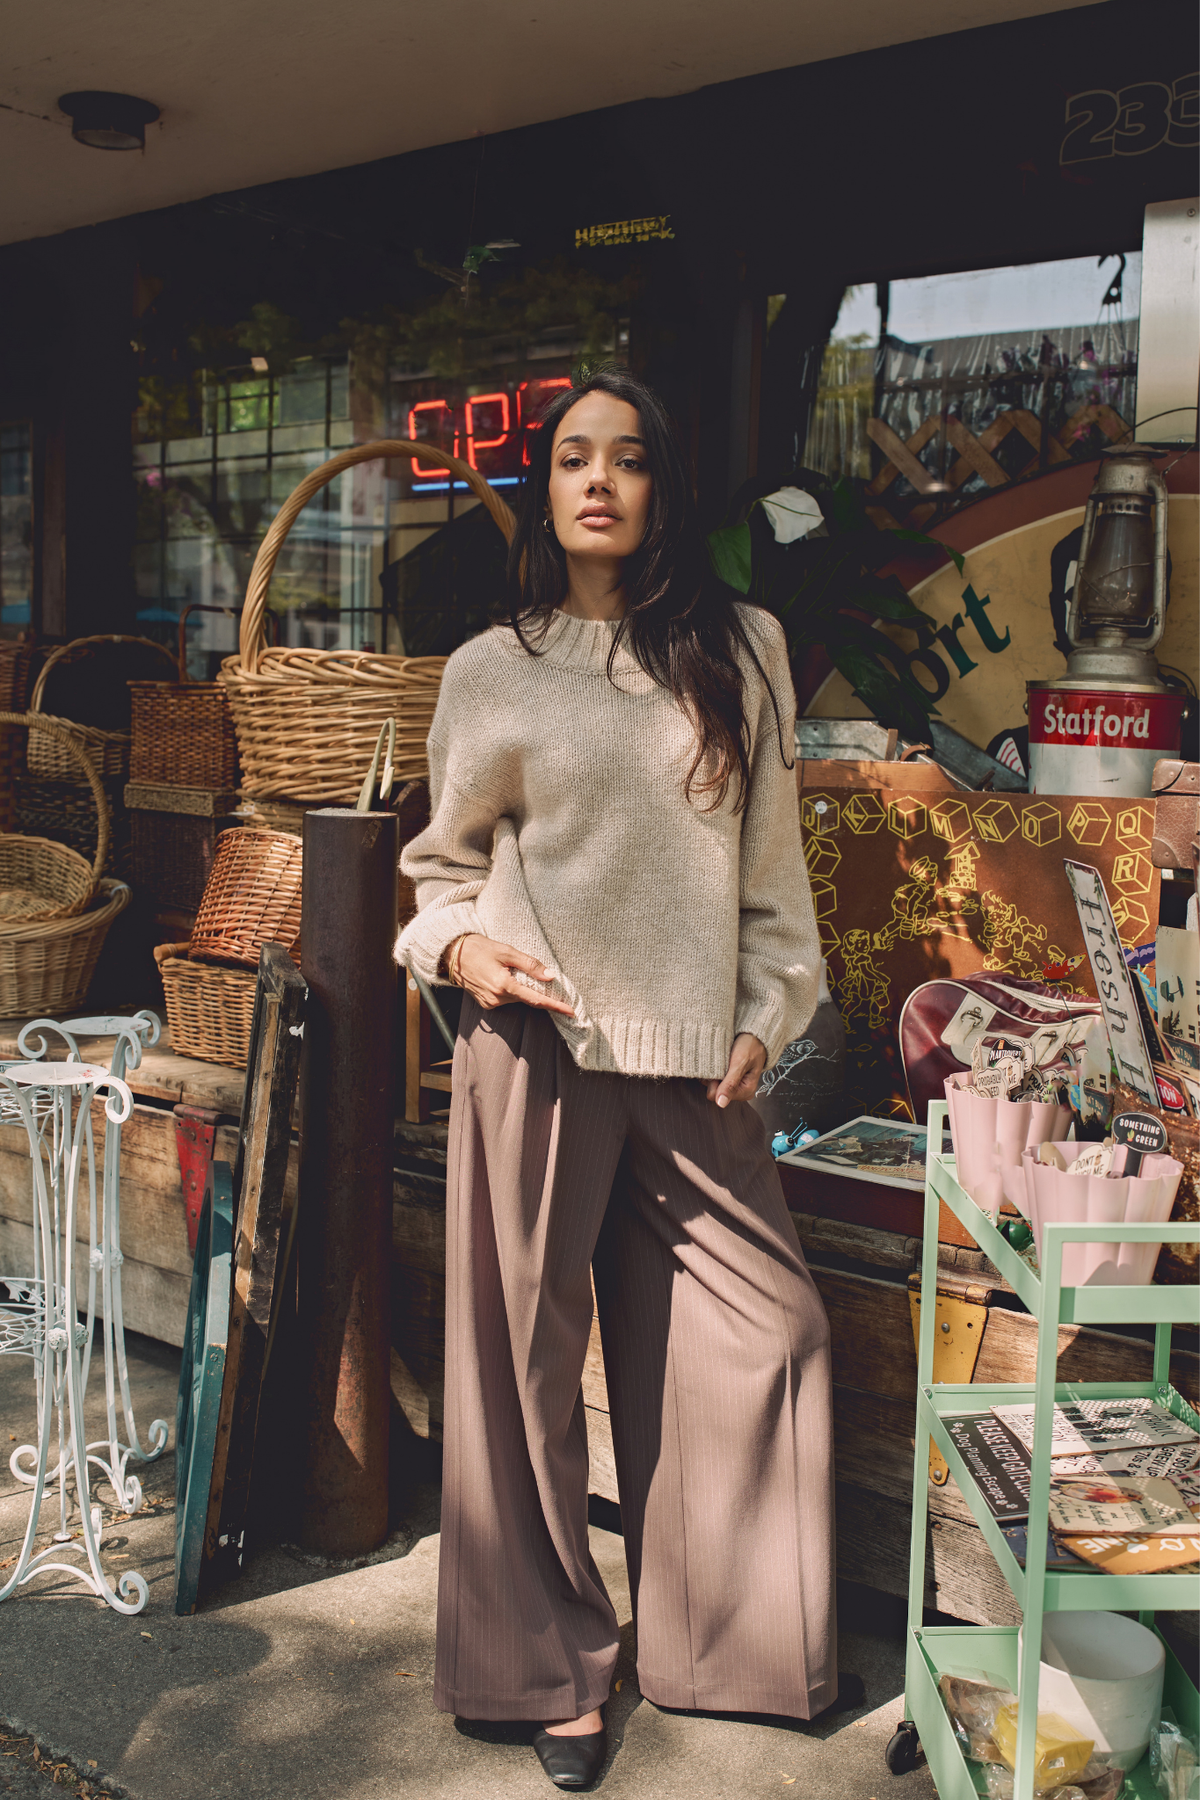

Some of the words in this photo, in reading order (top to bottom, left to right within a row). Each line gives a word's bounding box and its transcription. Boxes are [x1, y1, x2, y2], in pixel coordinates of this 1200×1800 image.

[845, 800, 866, 829] K
[891, 811, 904, 834] L
[932, 819, 951, 842] M
[978, 819, 1000, 841] N
[1071, 810, 1087, 831] P
[1119, 813, 1138, 836] Q
[1115, 857, 1134, 880] R
[1078, 893, 1128, 1033] Fresh
[989, 1085, 1001, 1097] EED
[1119, 1118, 1160, 1136] SOMETHING
[1135, 1134, 1159, 1148] GREEN
[974, 1419, 1009, 1445] PLEASE
[989, 1443, 1021, 1461] KEEP
[1151, 1446, 1176, 1467] GREW
[955, 1433, 972, 1448] Dog
[964, 1447, 991, 1477] Planning
[982, 1476, 1006, 1501] Escape
[1001, 1461, 1031, 1480] GATE
[1145, 1465, 1163, 1478] UP
[1172, 1457, 1190, 1470] SO
